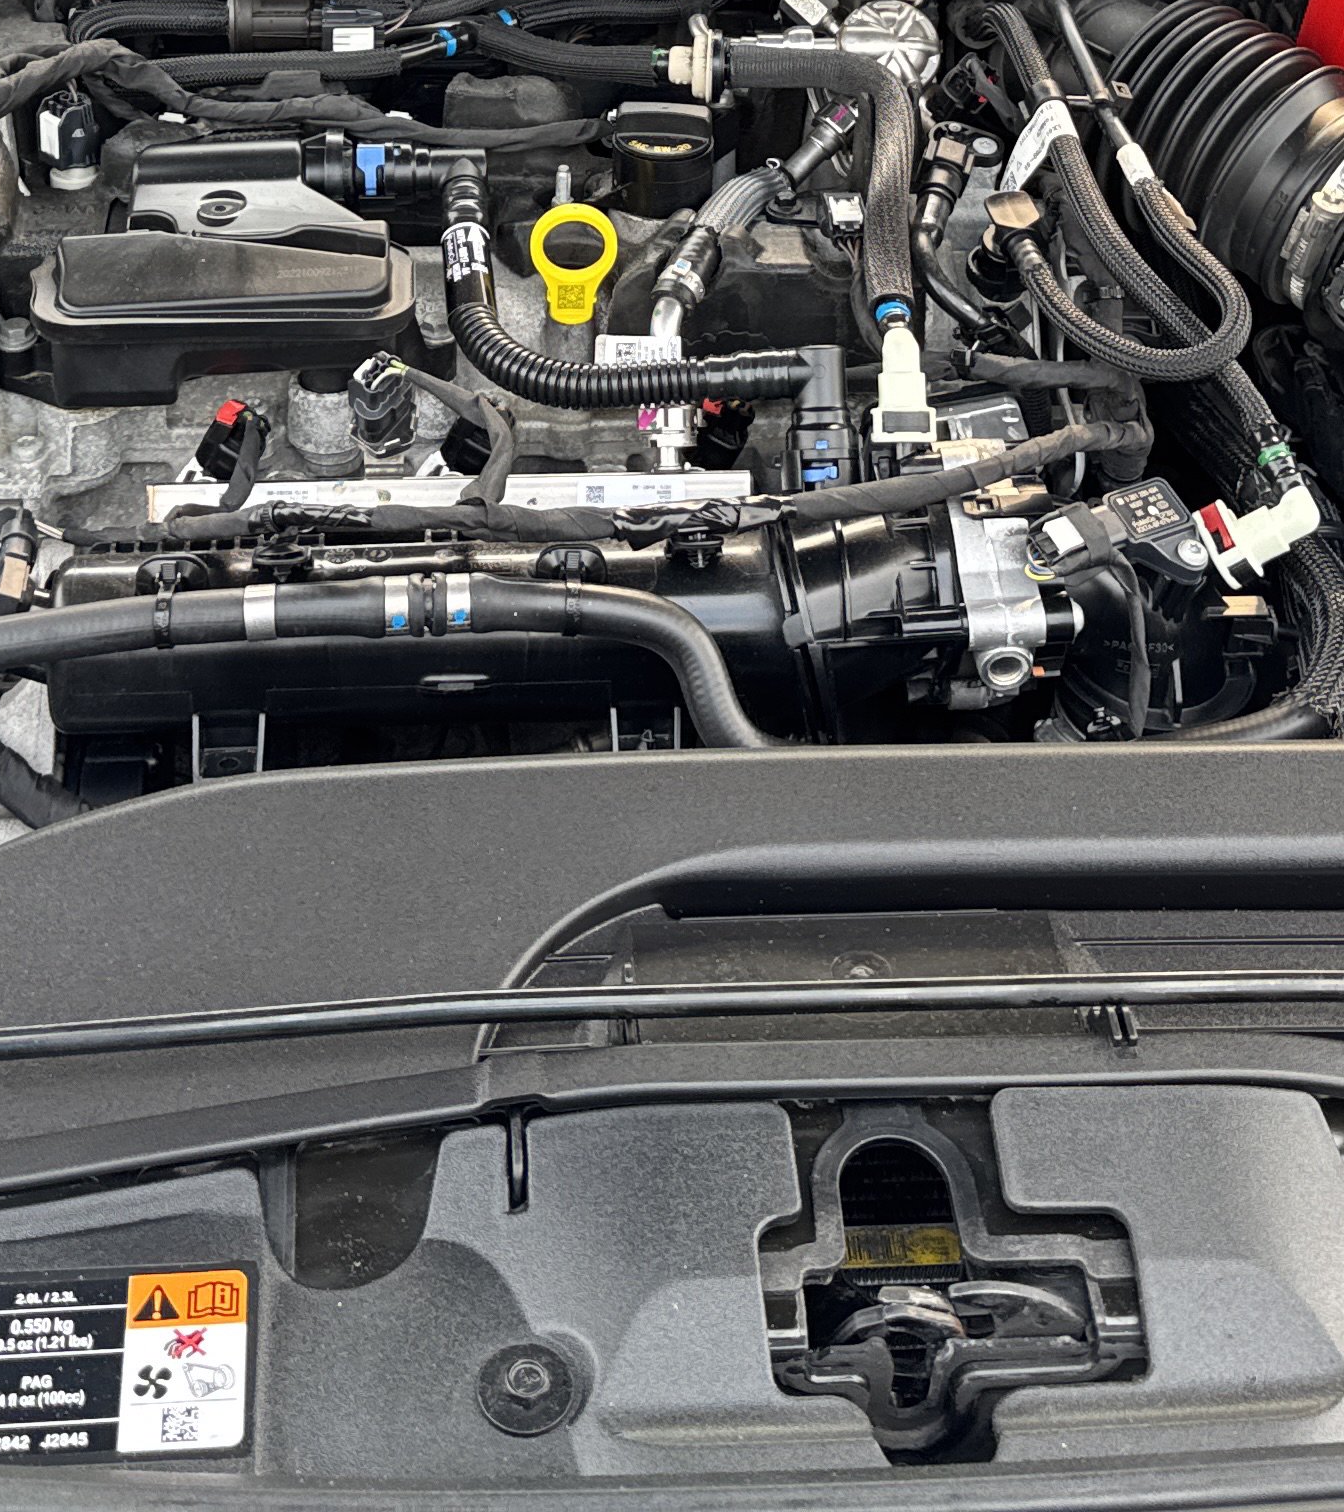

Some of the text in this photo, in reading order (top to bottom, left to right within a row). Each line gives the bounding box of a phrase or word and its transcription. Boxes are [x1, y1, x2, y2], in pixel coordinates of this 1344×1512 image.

[15, 1292, 42, 1305] 2.0L
[51, 1290, 77, 1303] 2.3L
[10, 1317, 74, 1335] 0.550 kg
[17, 1339, 33, 1351] oz
[35, 1336, 65, 1352] (1.21
[68, 1333, 94, 1350] lbs)
[20, 1375, 53, 1390] PAG
[19, 1393, 35, 1406] oz
[37, 1389, 85, 1408] (100cc)
[40, 1431, 89, 1449] J2845
